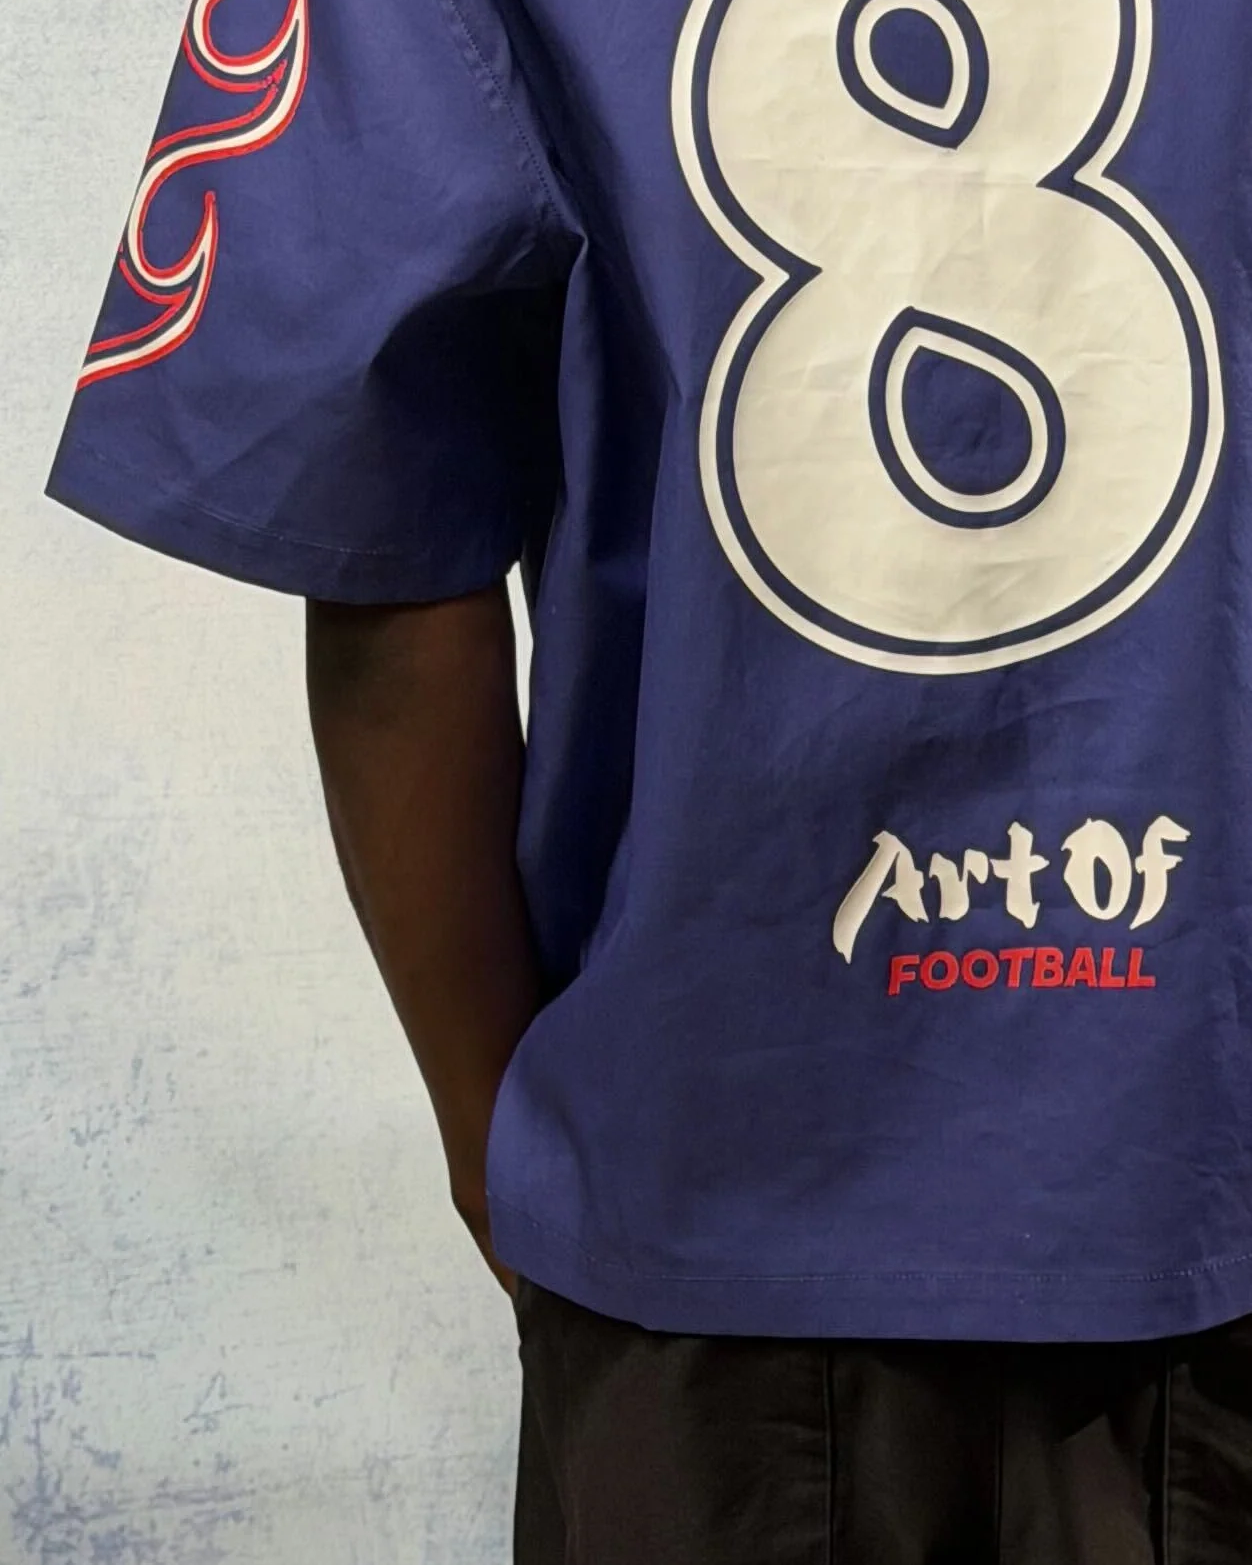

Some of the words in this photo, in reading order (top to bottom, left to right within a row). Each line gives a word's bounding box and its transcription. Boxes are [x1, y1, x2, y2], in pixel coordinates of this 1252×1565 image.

[833, 821, 1050, 964] Art
[1060, 815, 1191, 930] Of
[887, 946, 1157, 996] FOOTBALL
